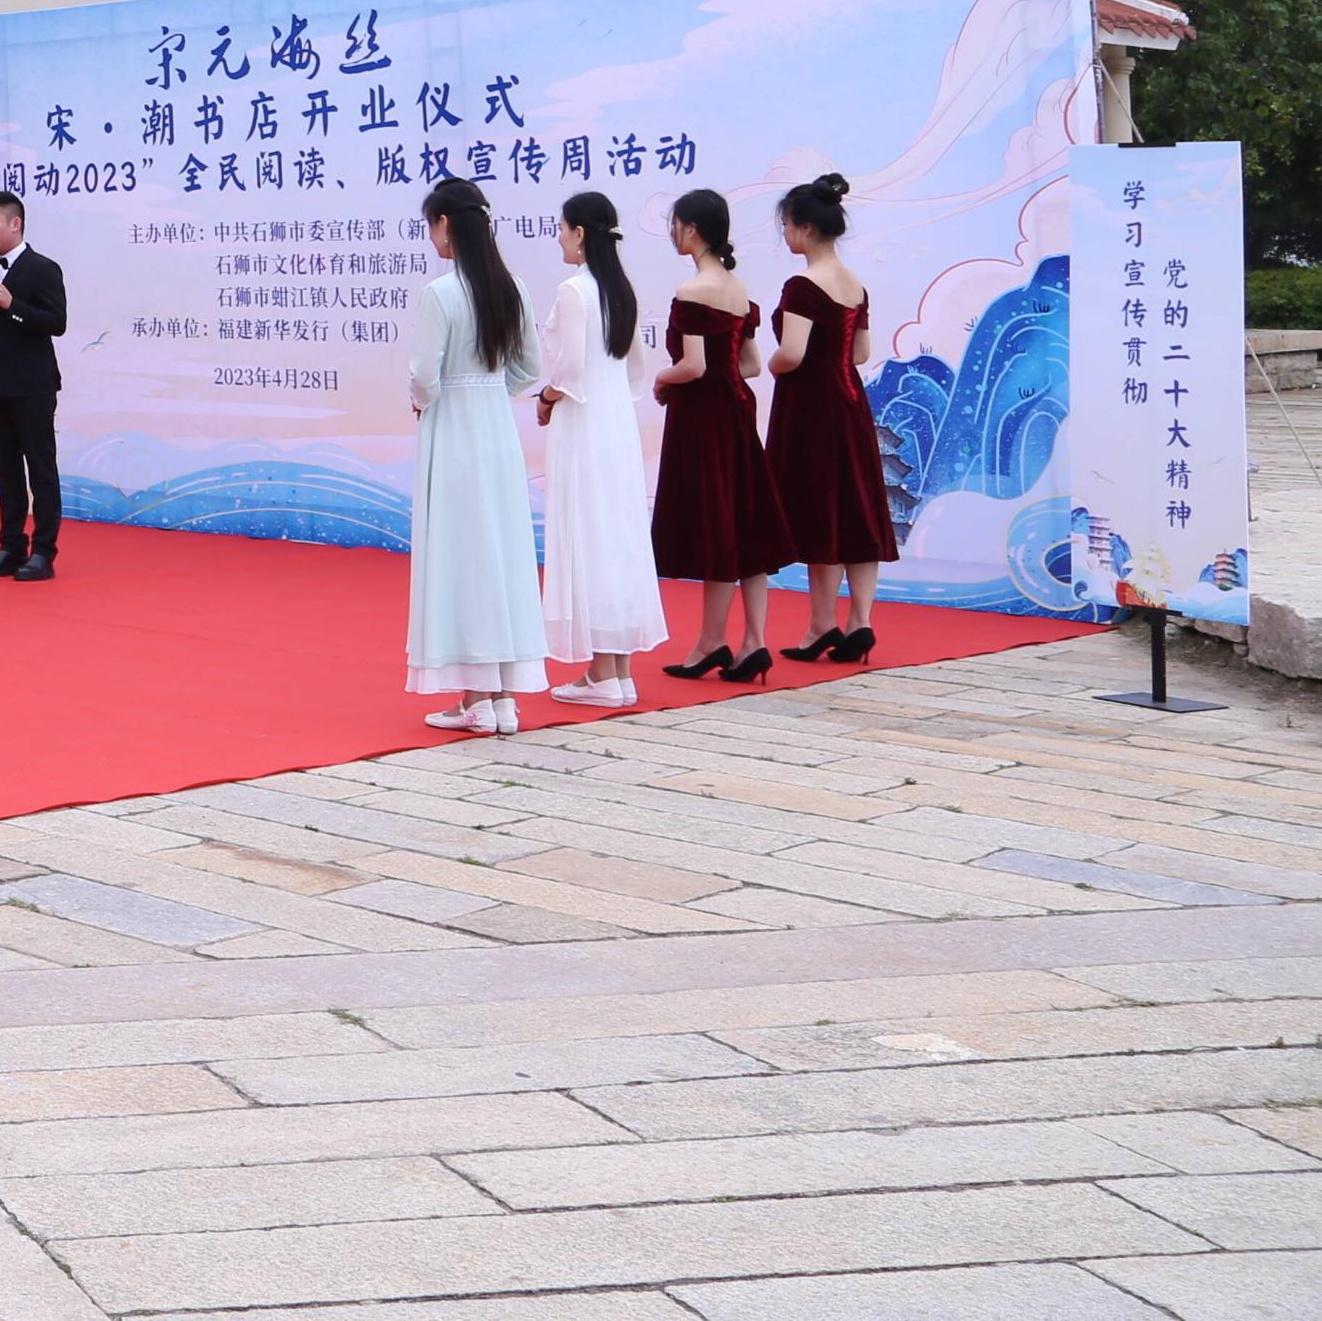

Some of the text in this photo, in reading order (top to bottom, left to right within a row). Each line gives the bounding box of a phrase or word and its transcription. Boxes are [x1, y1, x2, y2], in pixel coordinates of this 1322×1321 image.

[144, 9, 392, 90] 宋元海丝
[215, 252, 428, 276] 石狮市文化体育和旅游局
[217, 286, 409, 310] 石狮市蚶江镇人民政府
[1121, 180, 1150, 406] 学习宣传贯彻
[213, 366, 339, 391] 2023年4月28日
[1162, 257, 1193, 530] 党的二十大精神
